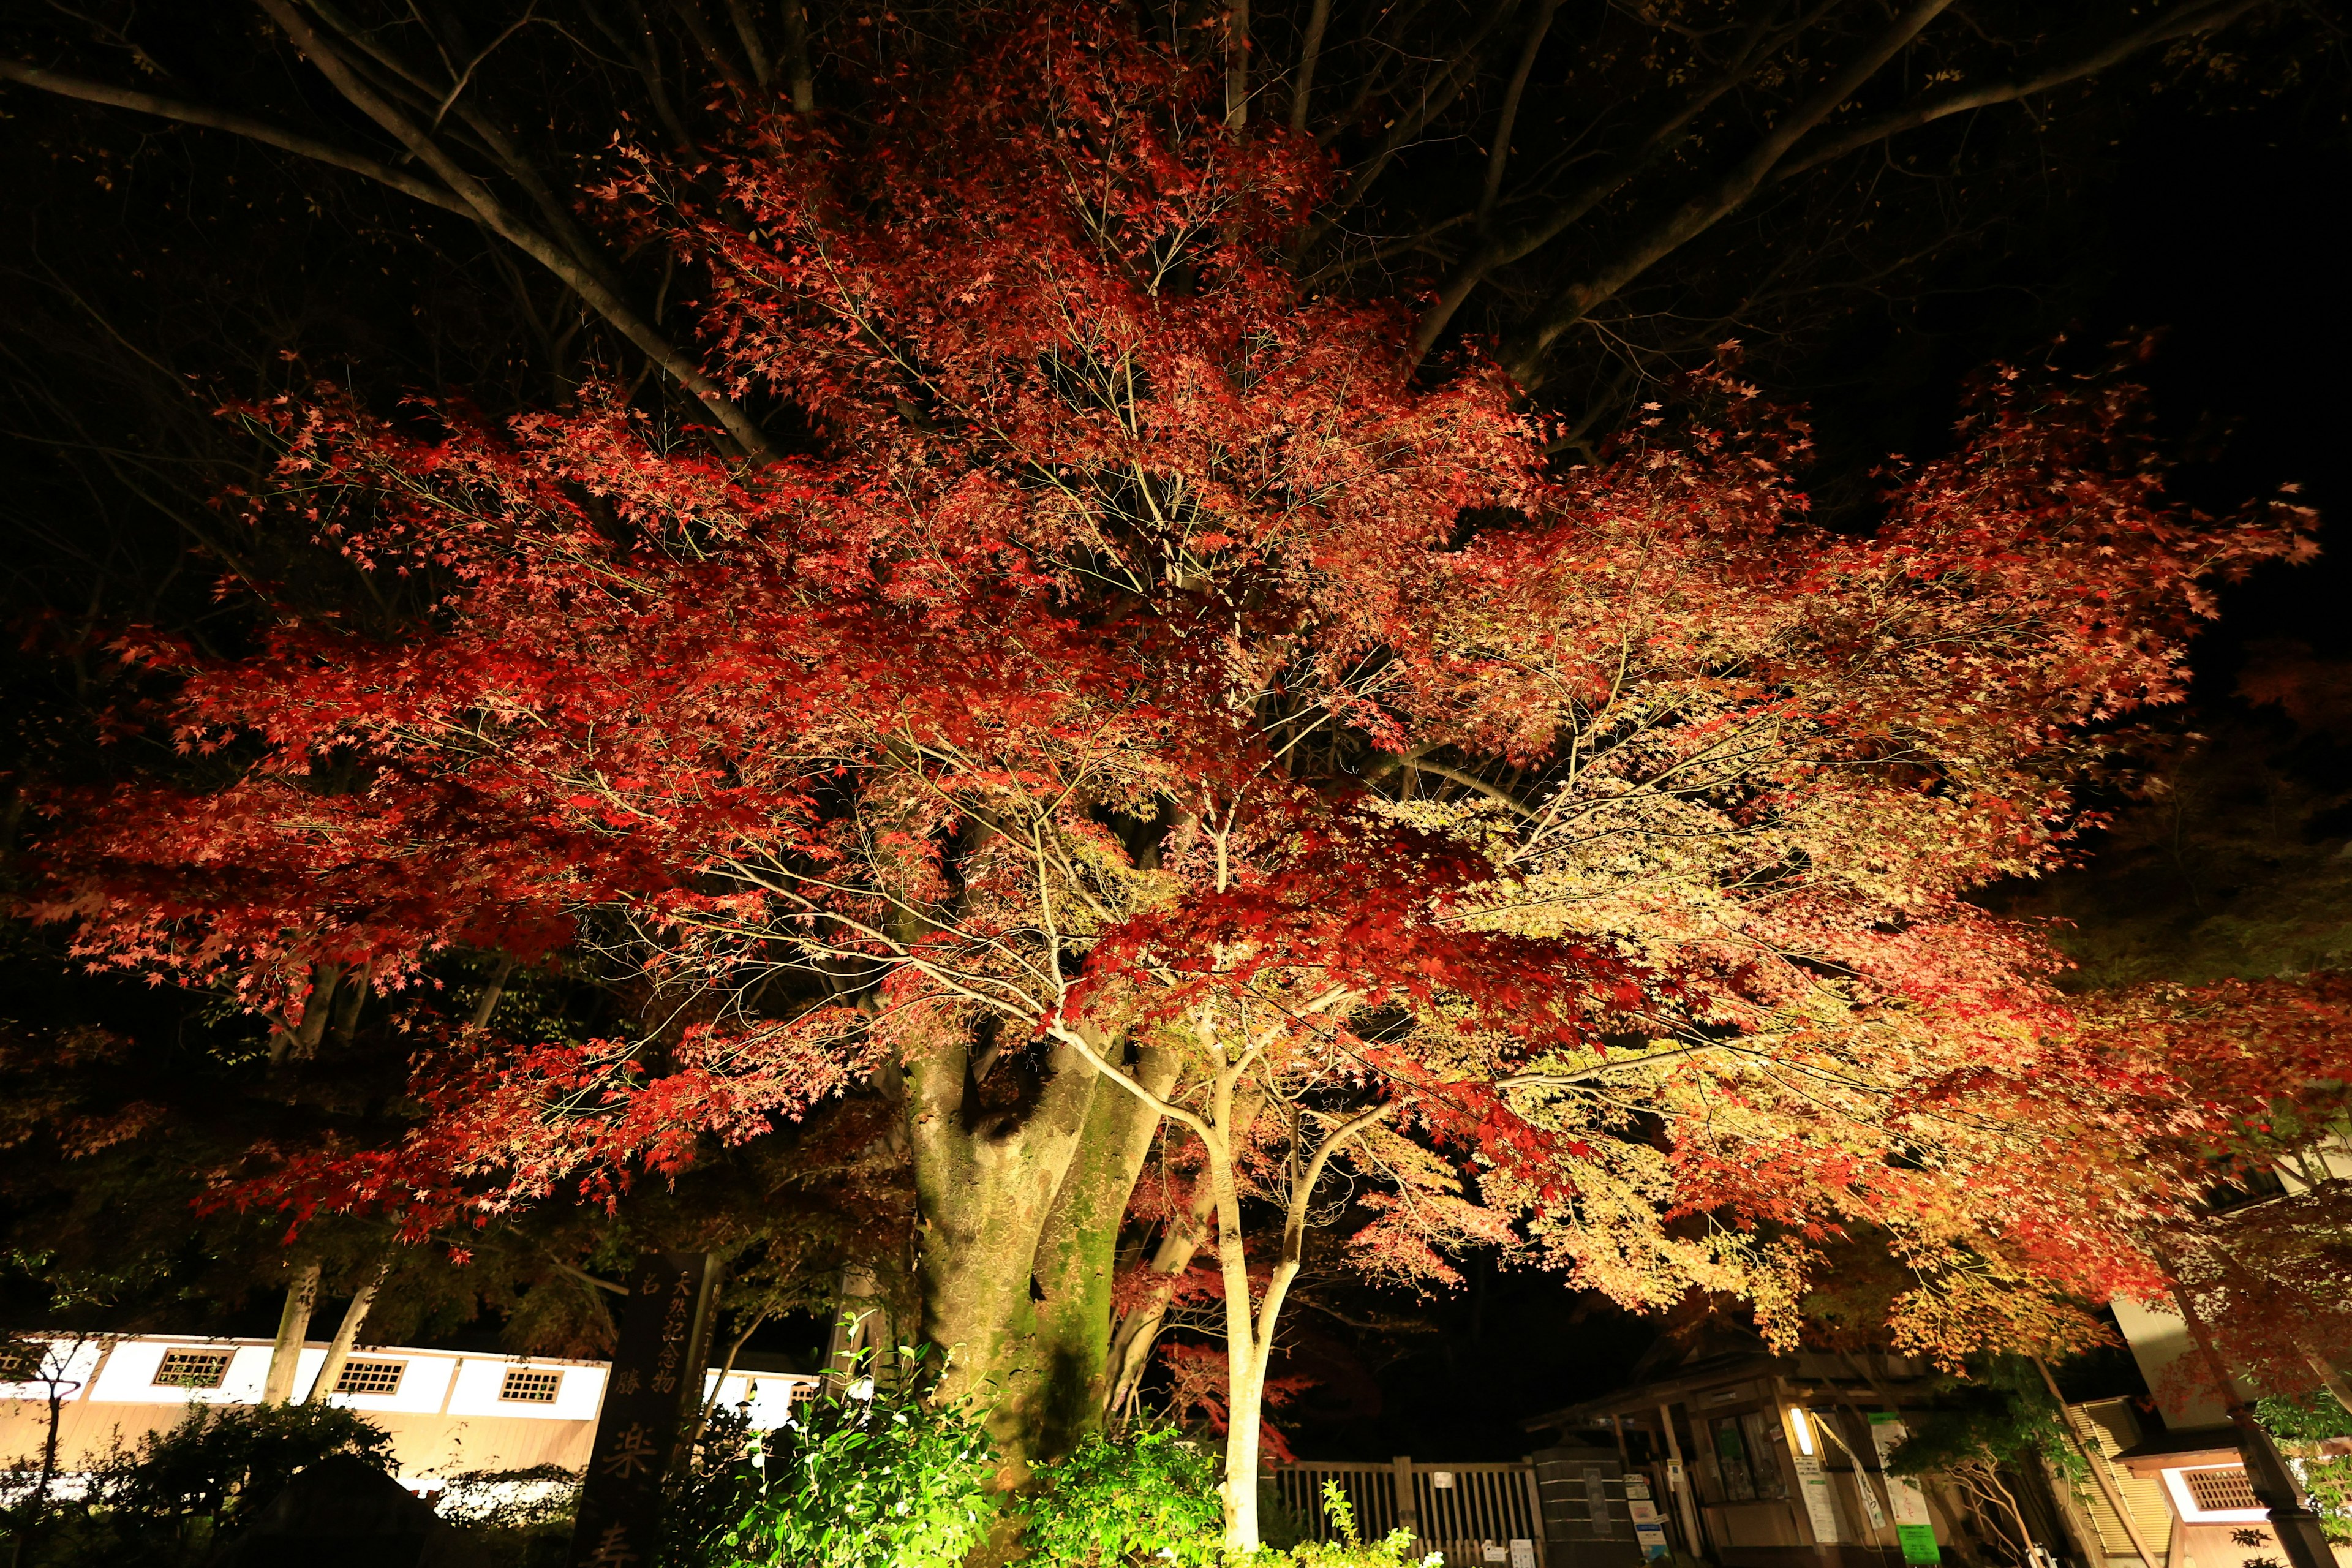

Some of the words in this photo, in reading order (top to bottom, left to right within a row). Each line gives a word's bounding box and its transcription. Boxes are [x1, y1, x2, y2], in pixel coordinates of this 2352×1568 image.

[650, 1270, 694, 1395] 天然記念物
